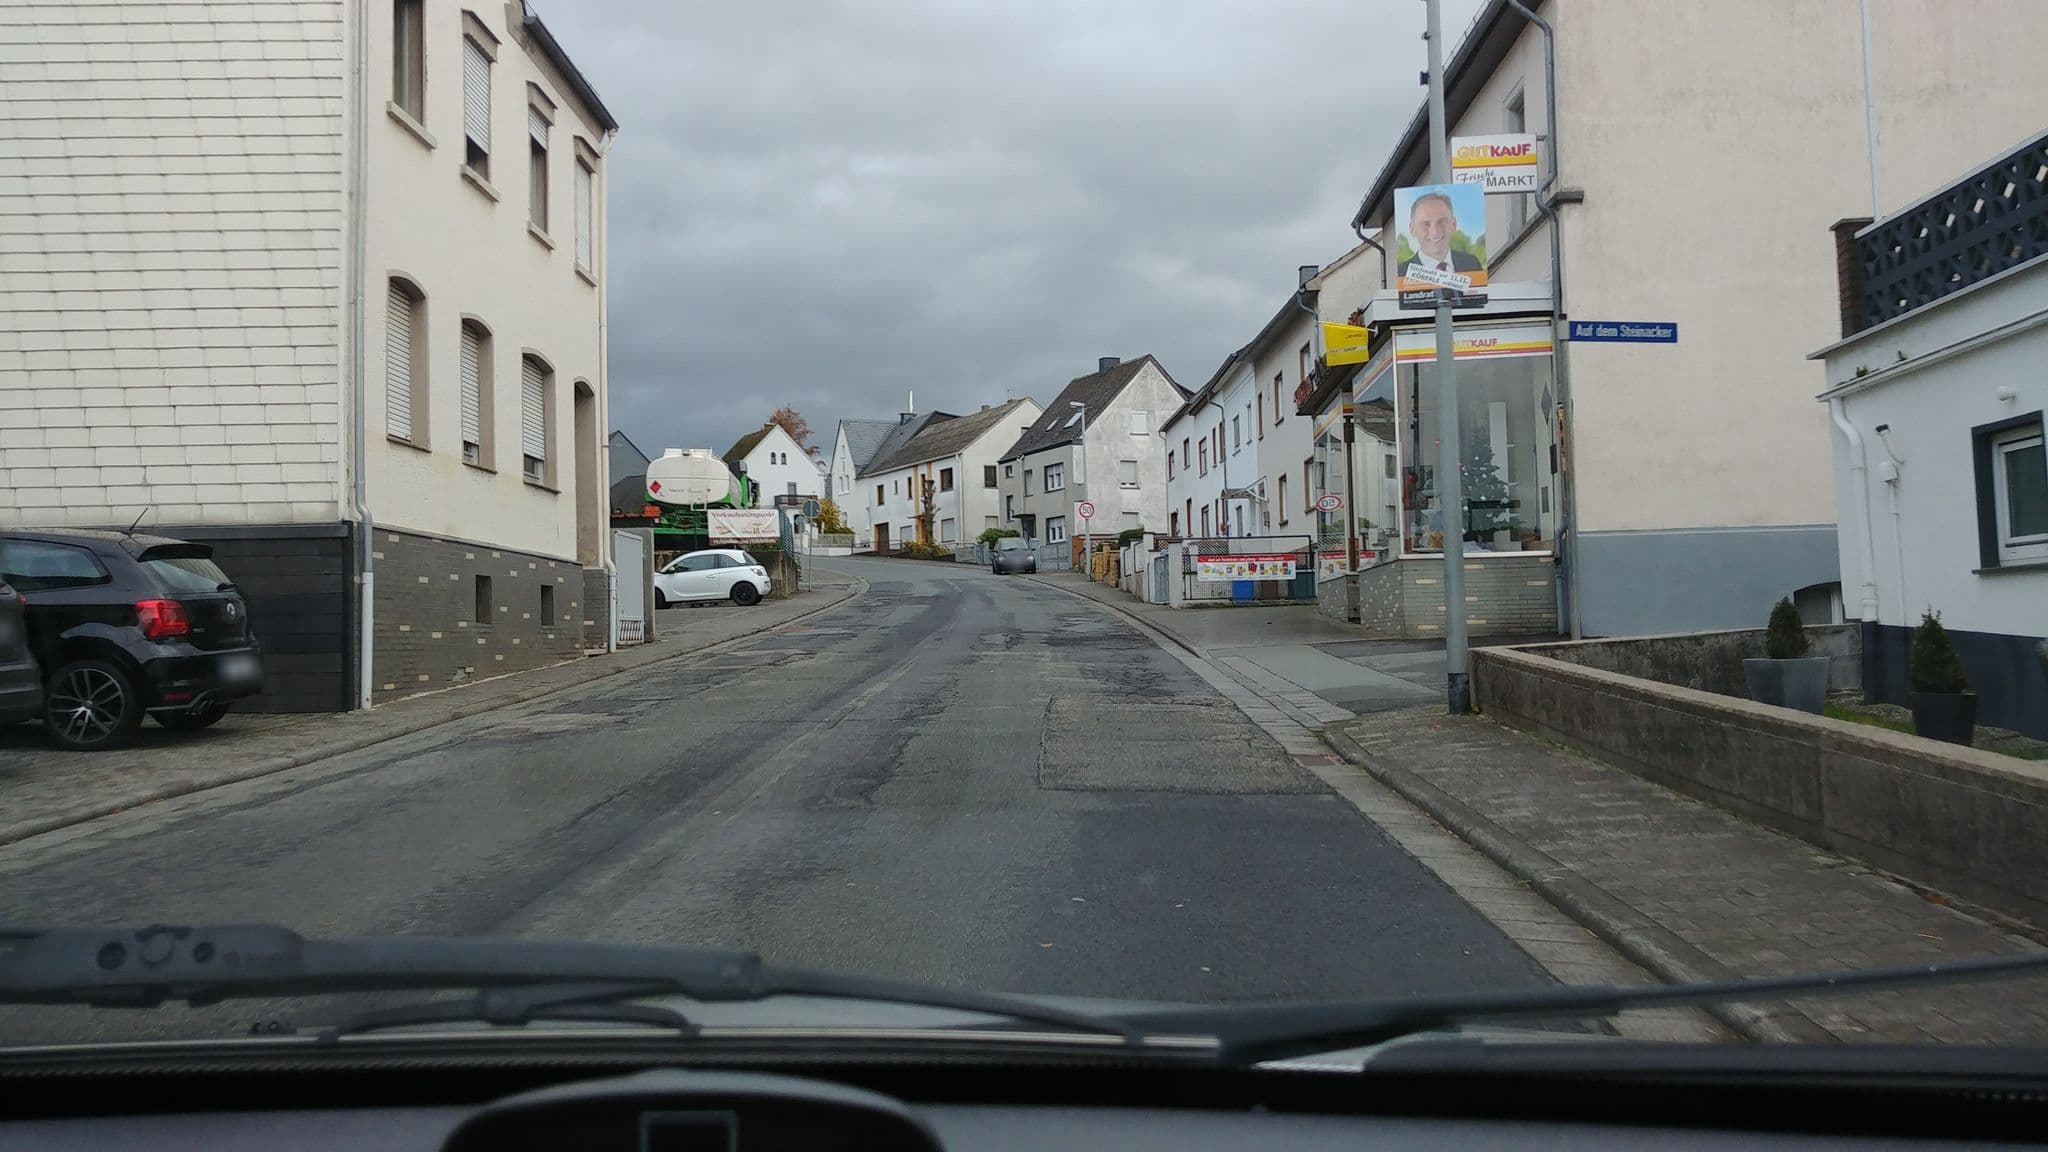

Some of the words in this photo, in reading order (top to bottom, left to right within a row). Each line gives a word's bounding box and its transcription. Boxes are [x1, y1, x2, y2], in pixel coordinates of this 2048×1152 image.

[1456, 143, 1531, 160] GUTKAUF
[1456, 168, 1494, 183] Frische
[1486, 175, 1535, 187] MARKT
[1403, 291, 1435, 300] Landrat
[1576, 323, 1593, 336] Auf
[1596, 324, 1618, 336] dem
[1620, 324, 1672, 337] Steinacker
[1082, 506, 1092, 515] 50
